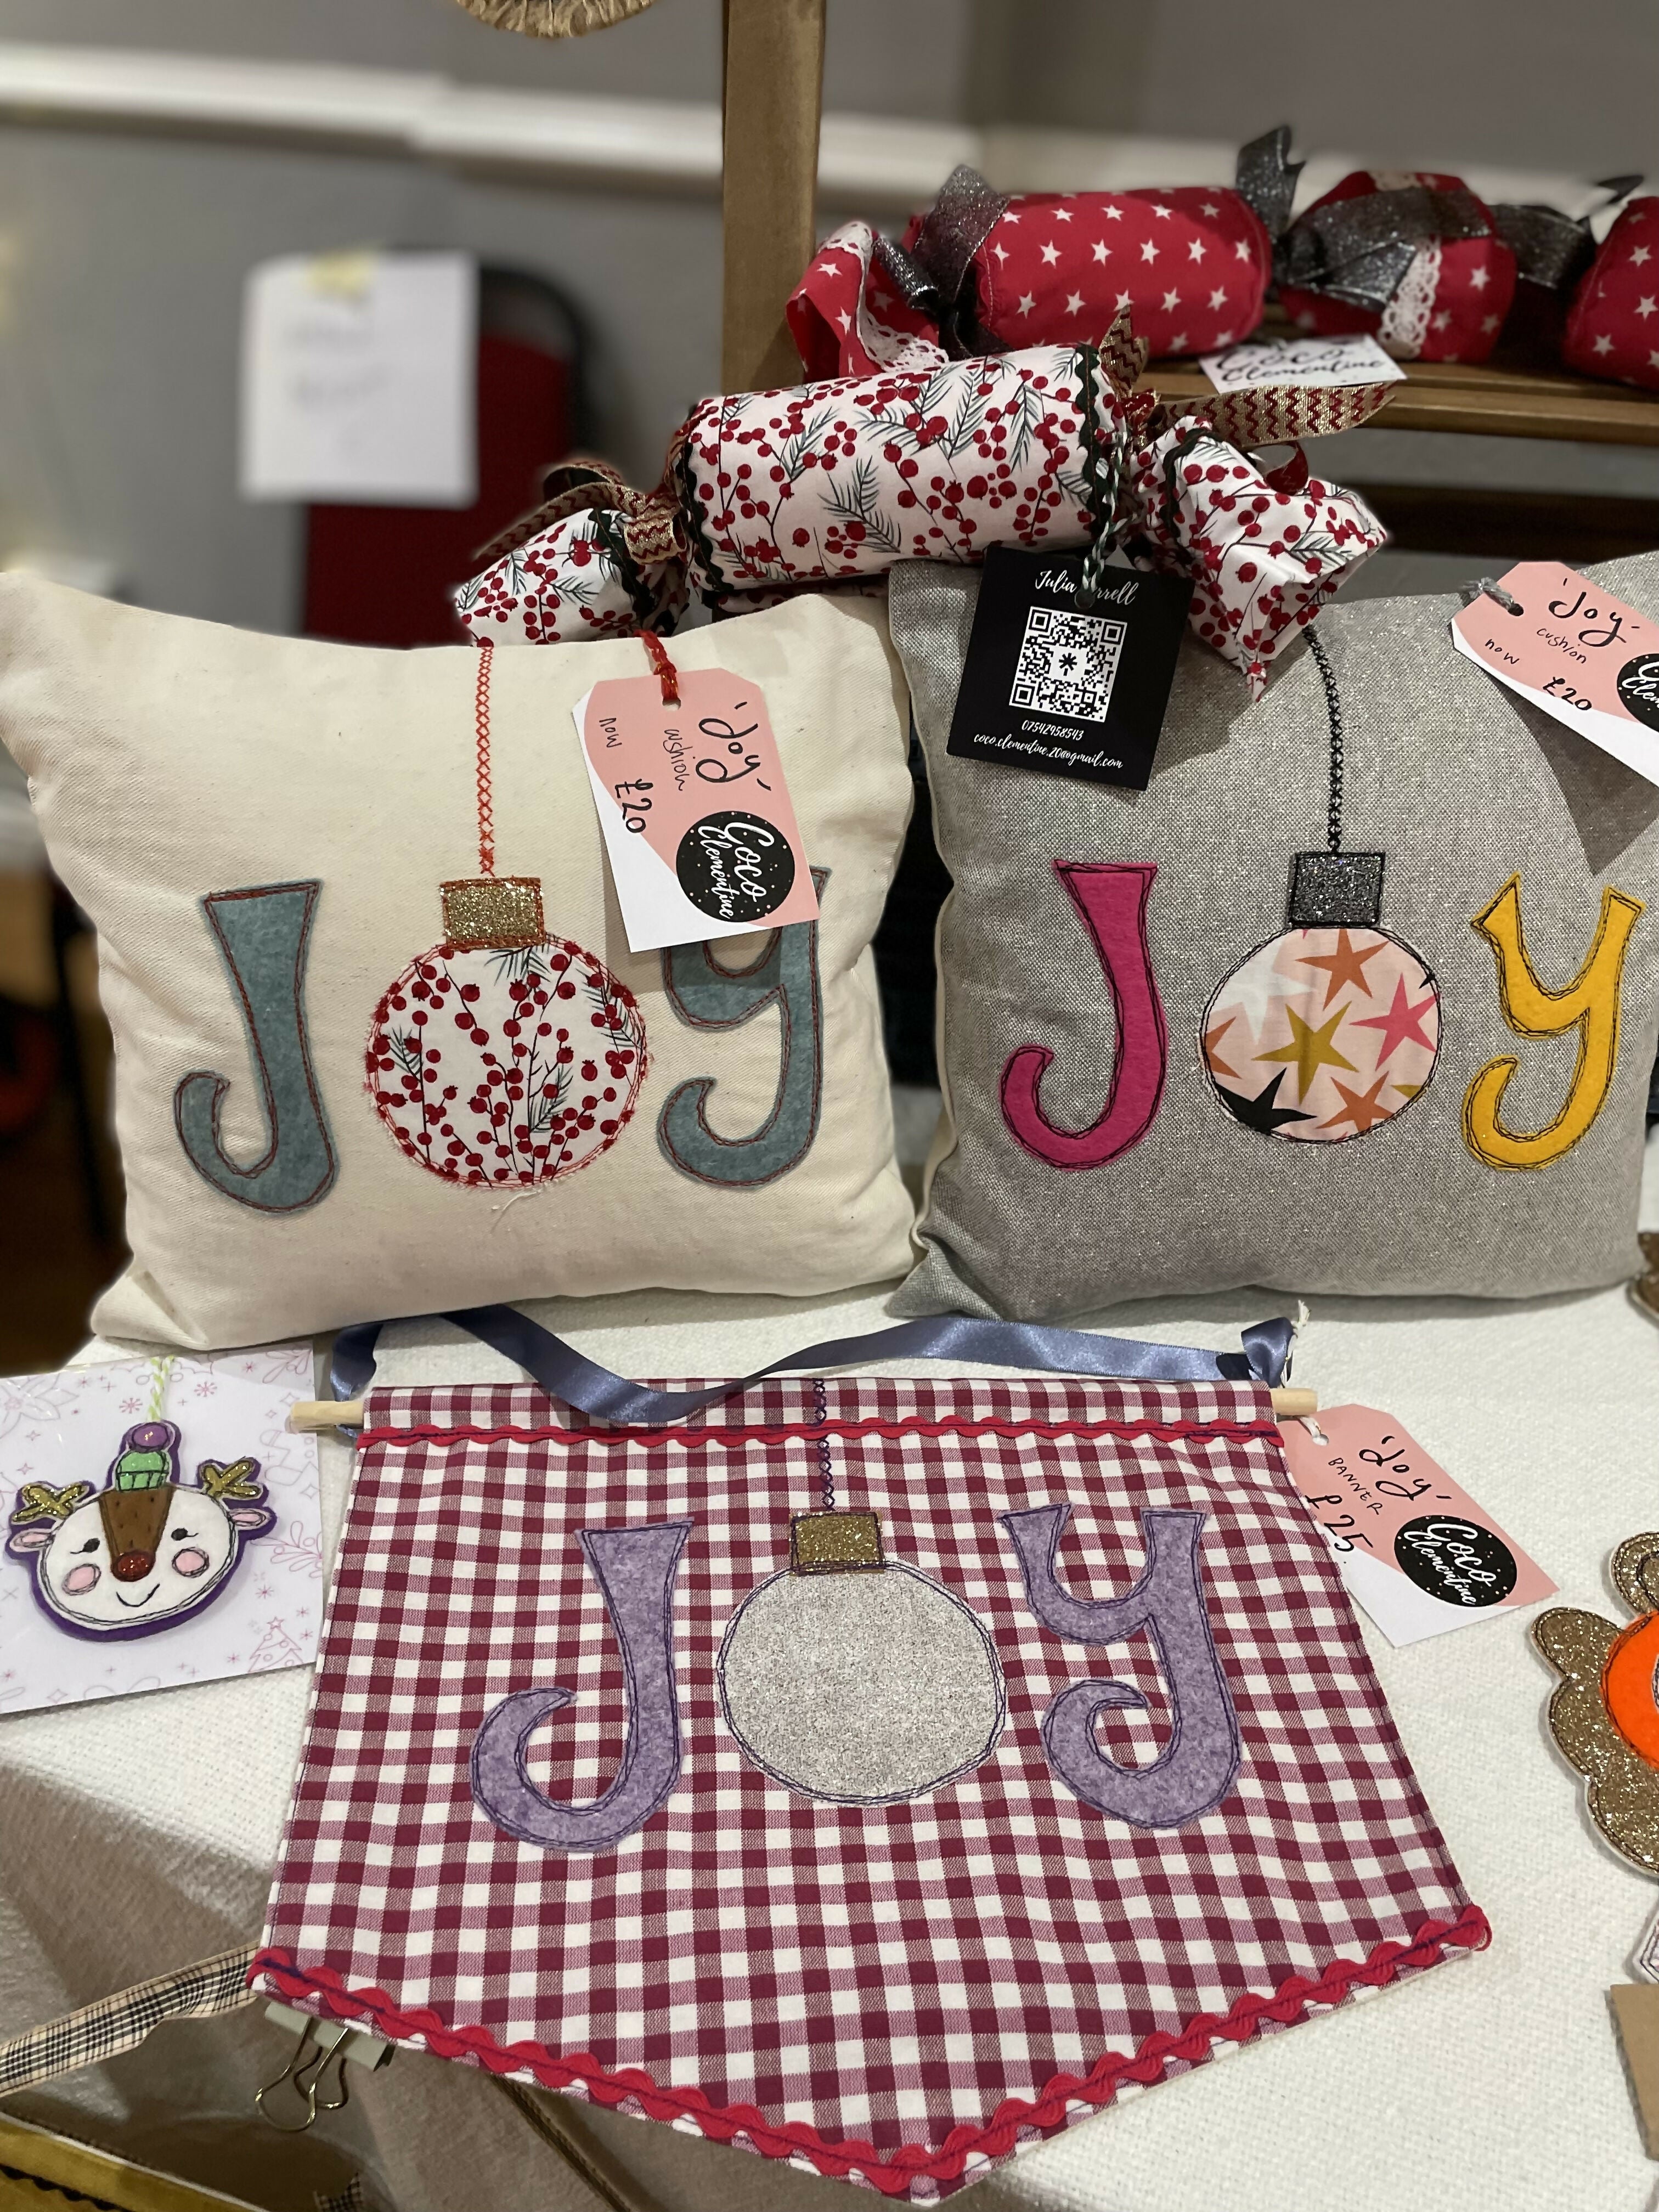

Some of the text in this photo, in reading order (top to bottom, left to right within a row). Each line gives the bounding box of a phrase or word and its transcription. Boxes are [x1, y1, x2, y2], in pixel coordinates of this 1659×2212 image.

[1035, 569, 1139, 605] Julia rrell
[1485, 639, 1520, 664] now
[1536, 628, 1588, 664] cushion
[1542, 676, 1593, 711] £20
[599, 717, 622, 748] now
[663, 729, 693, 791] cushion
[973, 733, 1124, 769] coco.clementine.20@gmail.com
[614, 778, 654, 833] £20
[698, 825, 735, 919] Clementine
[724, 822, 775, 903] Coco
[1327, 1457, 1383, 1516] BANNER
[1403, 1530, 1477, 1605] Clementine
[1426, 1523, 1497, 1587] Coco
